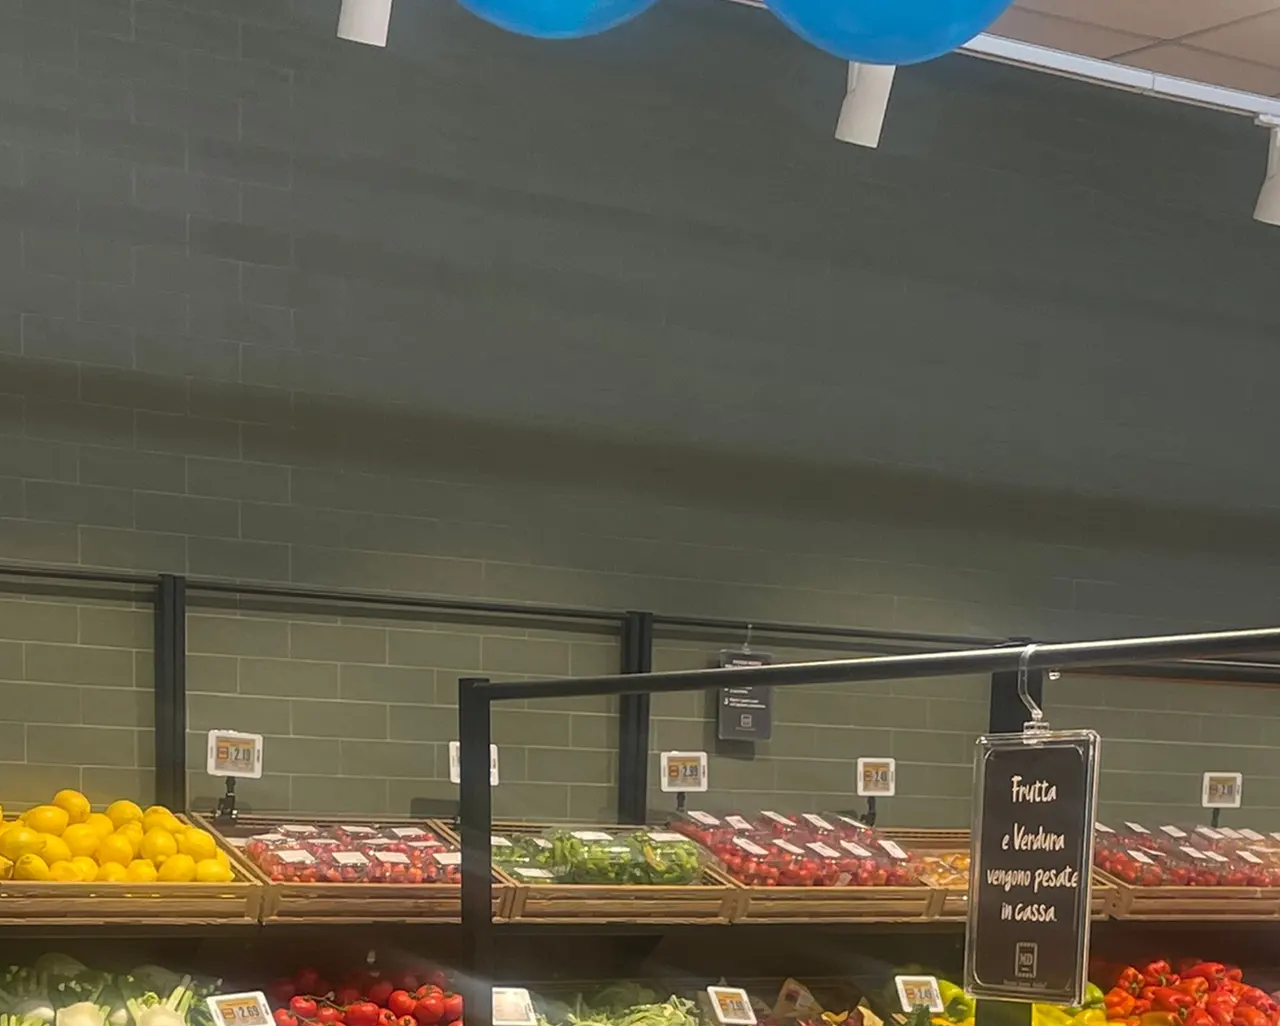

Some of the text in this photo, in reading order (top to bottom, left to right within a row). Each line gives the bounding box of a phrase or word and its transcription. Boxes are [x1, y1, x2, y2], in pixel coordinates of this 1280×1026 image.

[1011, 775, 1057, 803] Frutta
[1001, 822, 1065, 851] e Verdura
[986, 865, 1079, 893] vengono pesate
[1001, 902, 1013, 920] in
